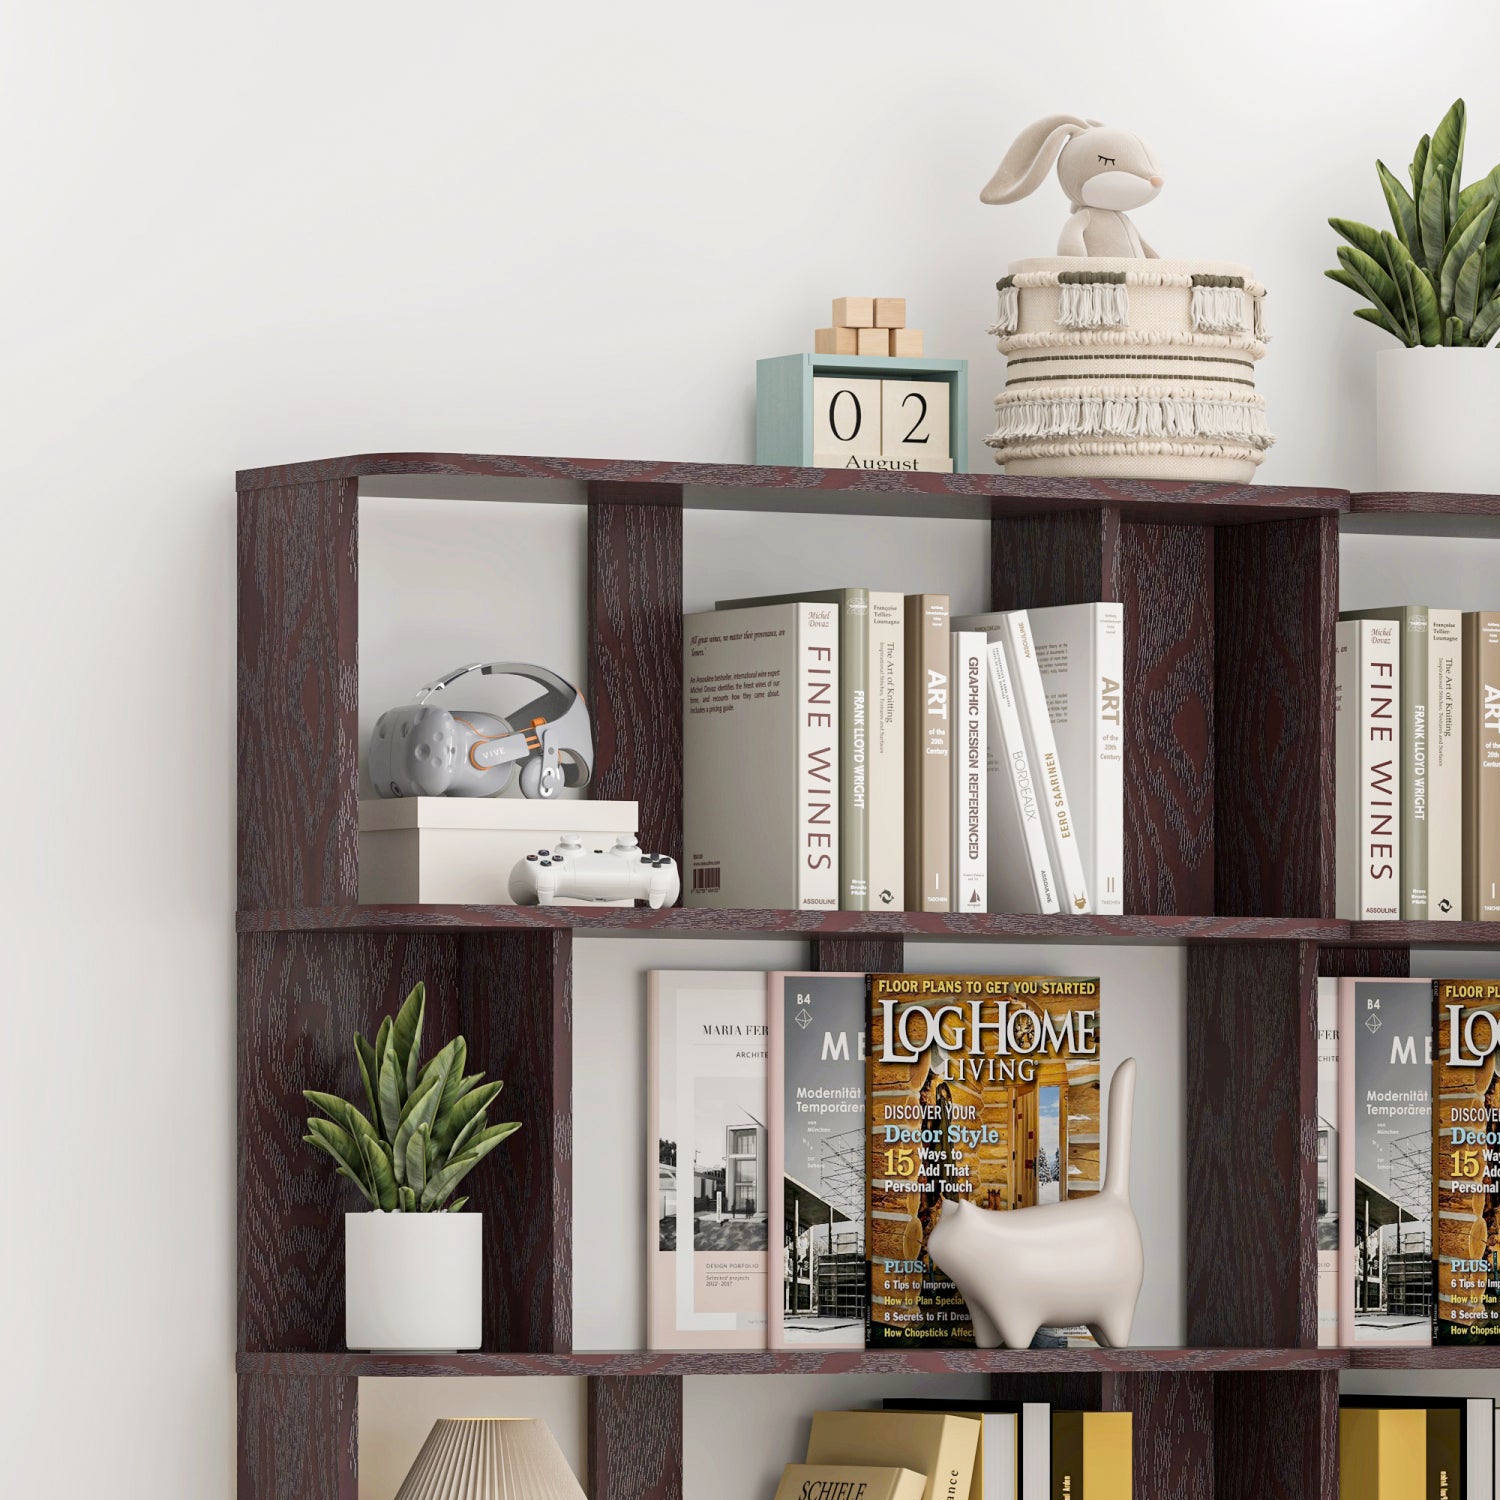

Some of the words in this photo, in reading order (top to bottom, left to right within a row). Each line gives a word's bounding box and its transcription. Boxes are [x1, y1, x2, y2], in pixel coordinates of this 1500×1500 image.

[829, 390, 861, 441] 0
[902, 393, 930, 443] 2
[846, 455, 919, 471] August
[808, 611, 830, 620] Michel
[808, 646, 831, 727] FINE
[888, 676, 894, 685] of
[927, 669, 947, 719] ART
[968, 657, 979, 716] GRAPHIC
[854, 690, 864, 726] FRANK
[1101, 677, 1120, 725] ART
[1371, 662, 1392, 741] FINE
[1414, 705, 1425, 740] FRANK
[854, 729, 864, 763] LLOYD
[968, 720, 979, 768] DESIGN
[1414, 742, 1425, 776] LLOYD
[854, 765, 864, 810] WRIGHT
[1013, 751, 1036, 822] BORDEAUX
[1045, 752, 1067, 809] SAARINEN
[808, 747, 831, 869] WINES
[1414, 778, 1425, 820] WRIGHT
[968, 773, 979, 860] REFERENCED
[1057, 811, 1071, 839] EERO
[1371, 760, 1392, 879] WINES
[796, 993, 811, 1005] B4
[879, 980, 918, 993] FLOOR
[923, 980, 962, 993] PLANS
[966, 981, 982, 994] TO
[986, 981, 1009, 994] GET
[1014, 982, 1037, 994] YOU
[1042, 982, 1096, 995] STARTED
[1367, 999, 1380, 1010] B4
[702, 1025, 742, 1036] MARIA
[943, 1058, 1036, 1081] LIVING
[796, 1087, 861, 1099] Modernität
[796, 1101, 866, 1115] Temporären
[884, 1105, 941, 1120] DISCOVER
[945, 1105, 976, 1120] YOUR
[884, 1124, 943, 1144] Decor
[947, 1124, 999, 1149] Style
[884, 1148, 915, 1177] 15
[917, 1147, 947, 1162] Ways
[951, 1148, 963, 1160] to
[917, 1163, 940, 1177] Add
[944, 1163, 970, 1177] That
[884, 1180, 935, 1193] Personal
[939, 1180, 973, 1193] Touch
[1450, 1260, 1491, 1273] PLUS:
[1451, 1279, 1457, 1288] 6
[1460, 1279, 1475, 1289] Tips
[1477, 1279, 1486, 1288] to
[1450, 1326, 1468, 1335] How
